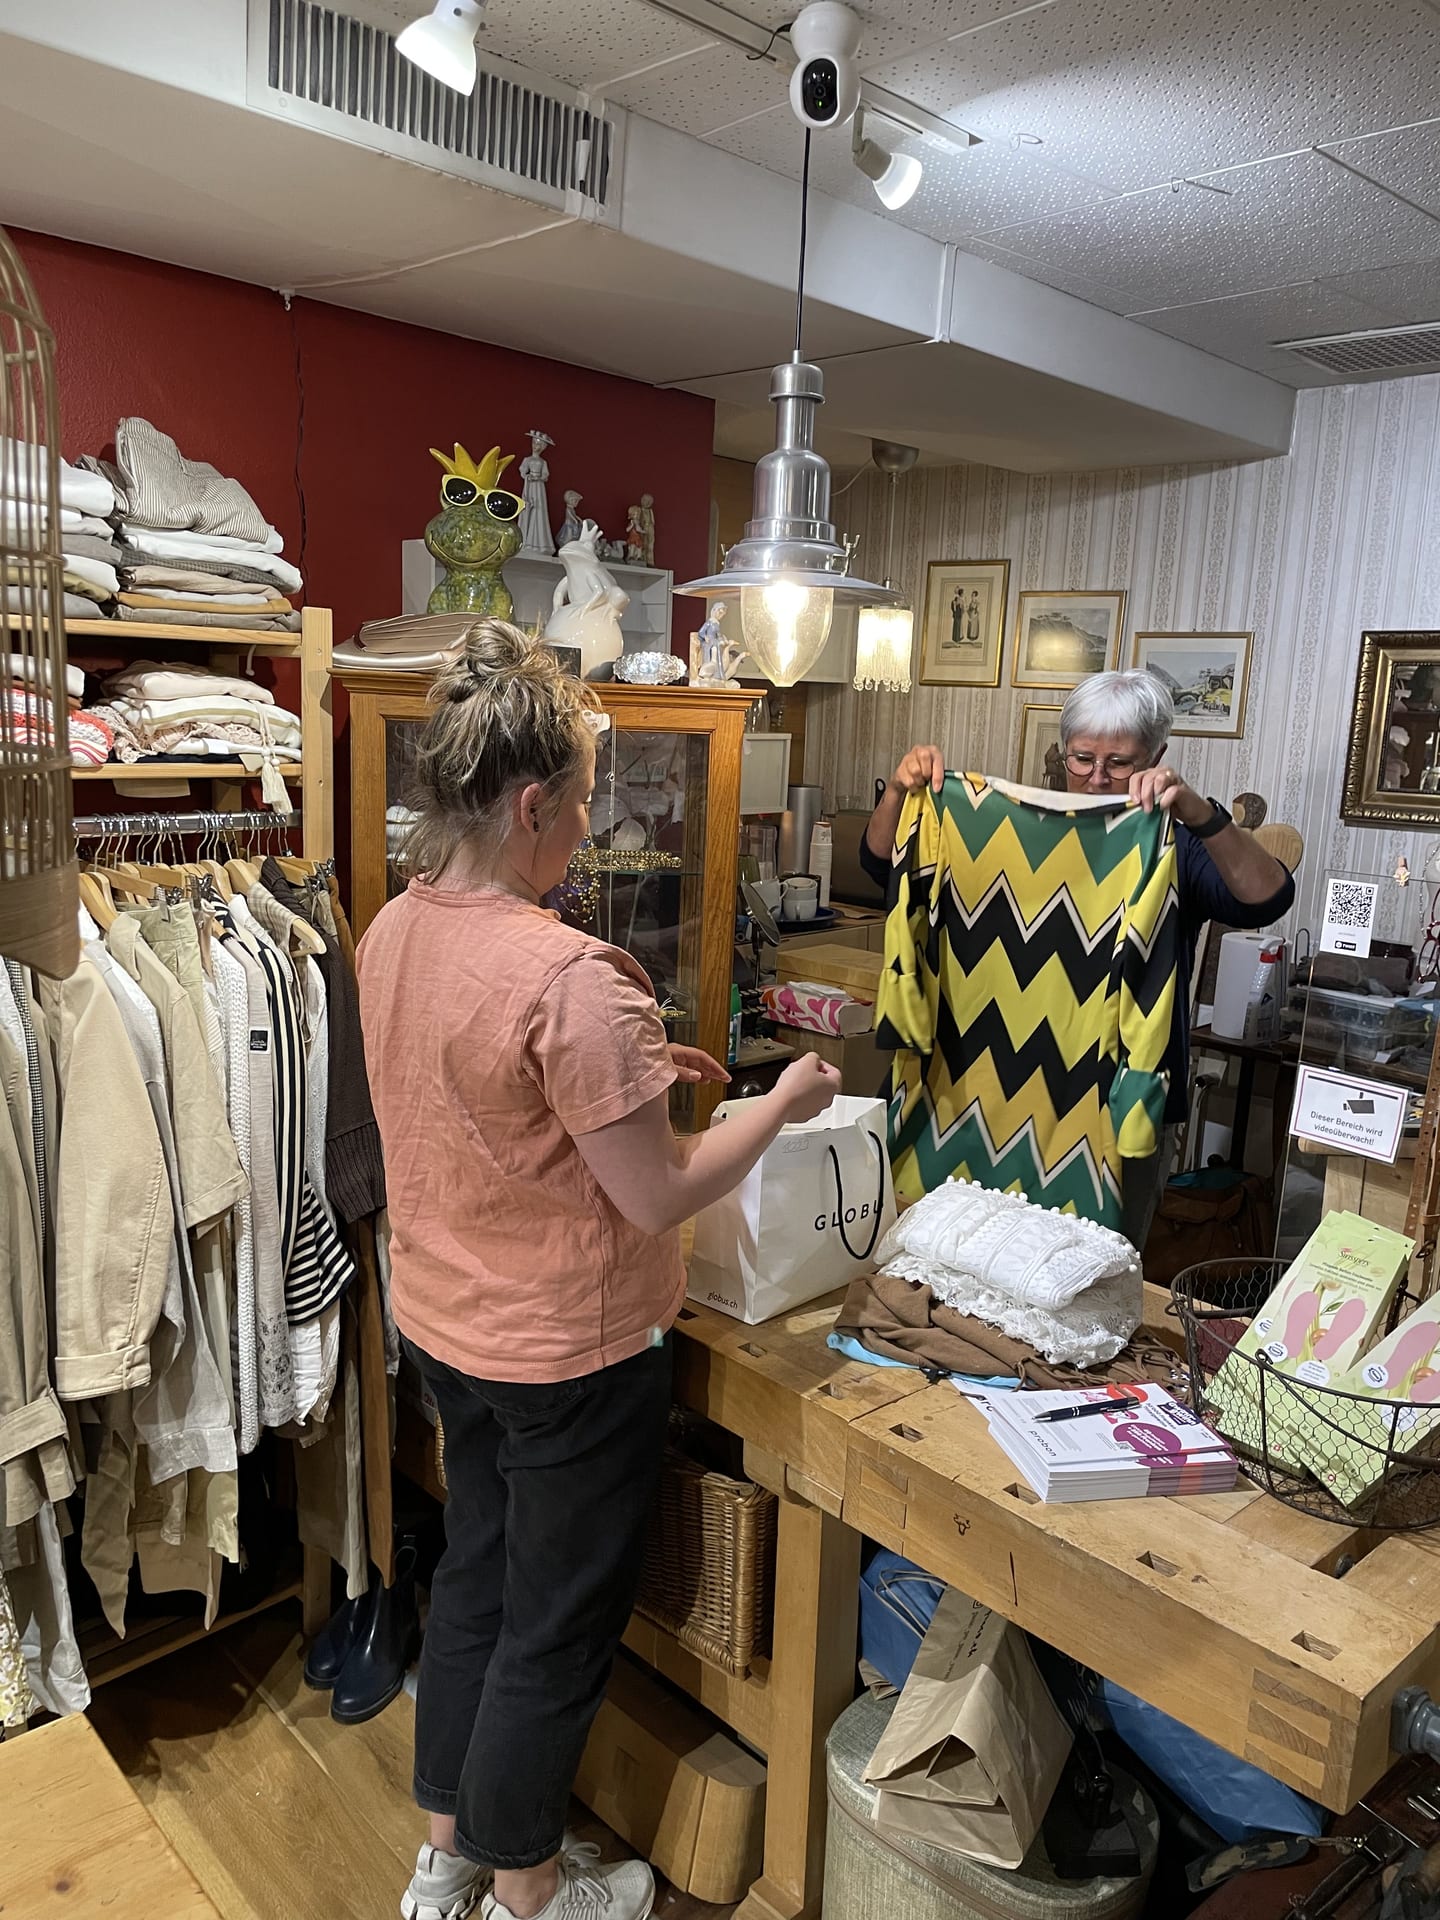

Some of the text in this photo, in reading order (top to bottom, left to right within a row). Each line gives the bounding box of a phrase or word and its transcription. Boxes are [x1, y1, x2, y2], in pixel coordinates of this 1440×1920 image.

[1310, 1110, 1384, 1137] Dieser Bereich wird
[1314, 1124, 1375, 1146] videoüberwacht!
[814, 1197, 884, 1231] GLOBU
[706, 1291, 738, 1309] globus.ch
